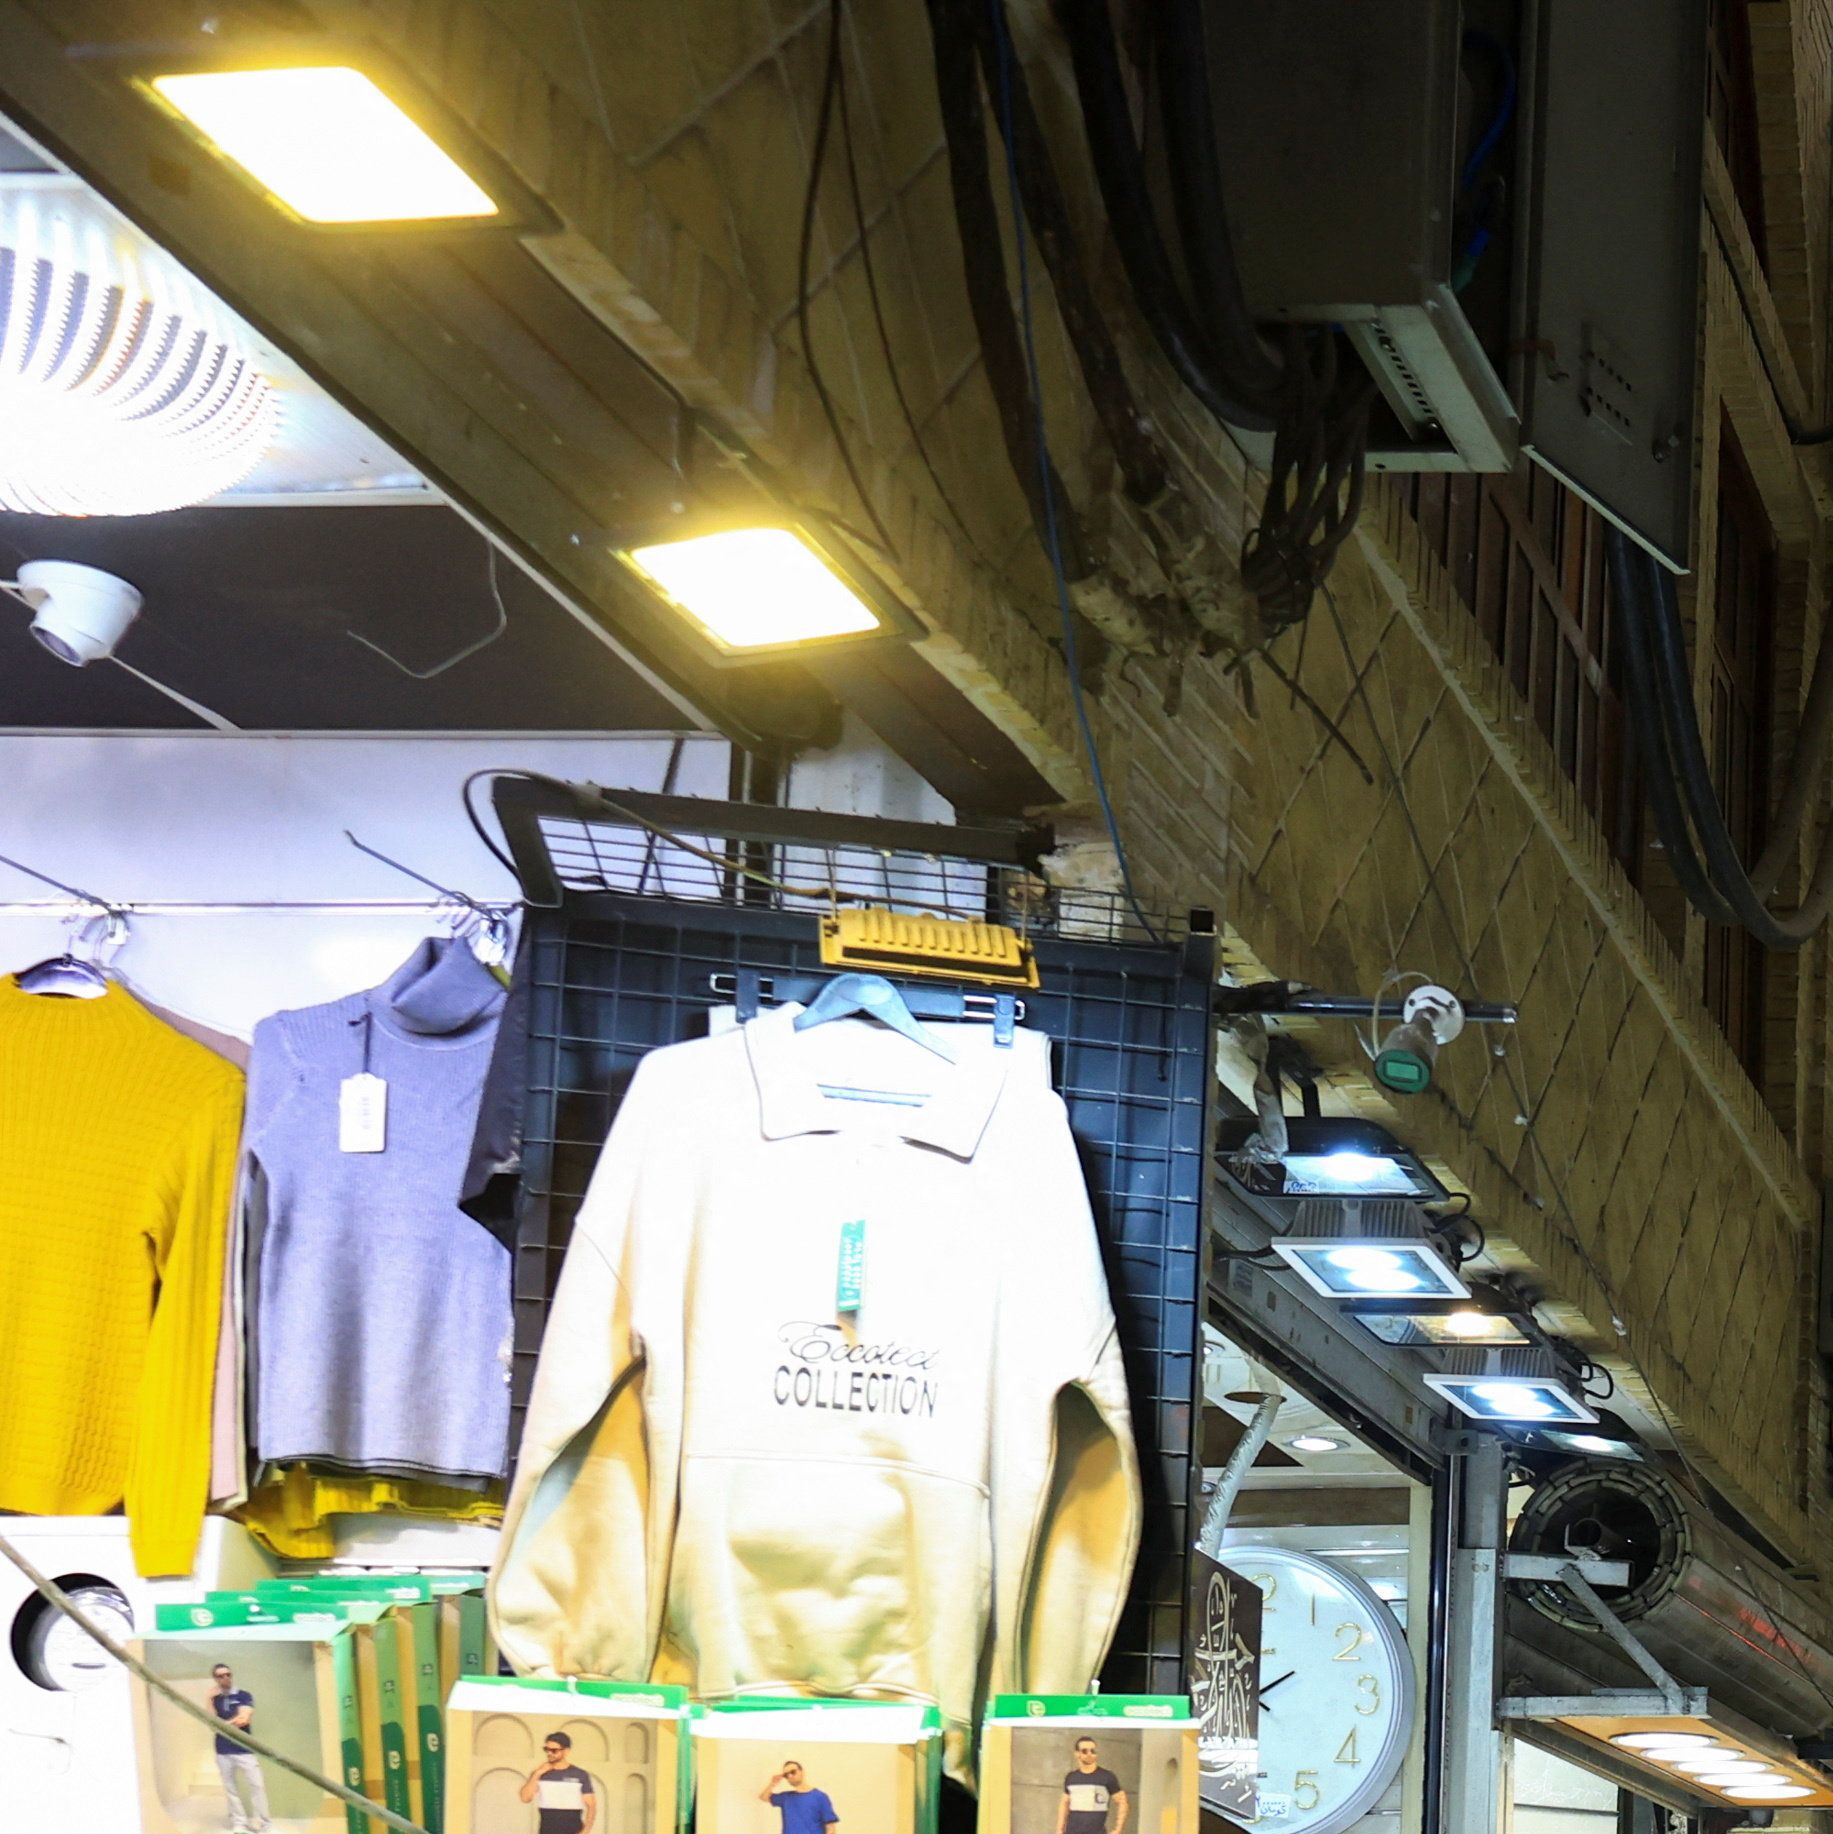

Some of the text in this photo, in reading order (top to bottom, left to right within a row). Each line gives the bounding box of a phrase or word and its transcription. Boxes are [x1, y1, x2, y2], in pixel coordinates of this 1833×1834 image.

[774, 1365, 939, 1418] COLLECTION
[1295, 1623, 1380, 1810] 2 3 4 5
